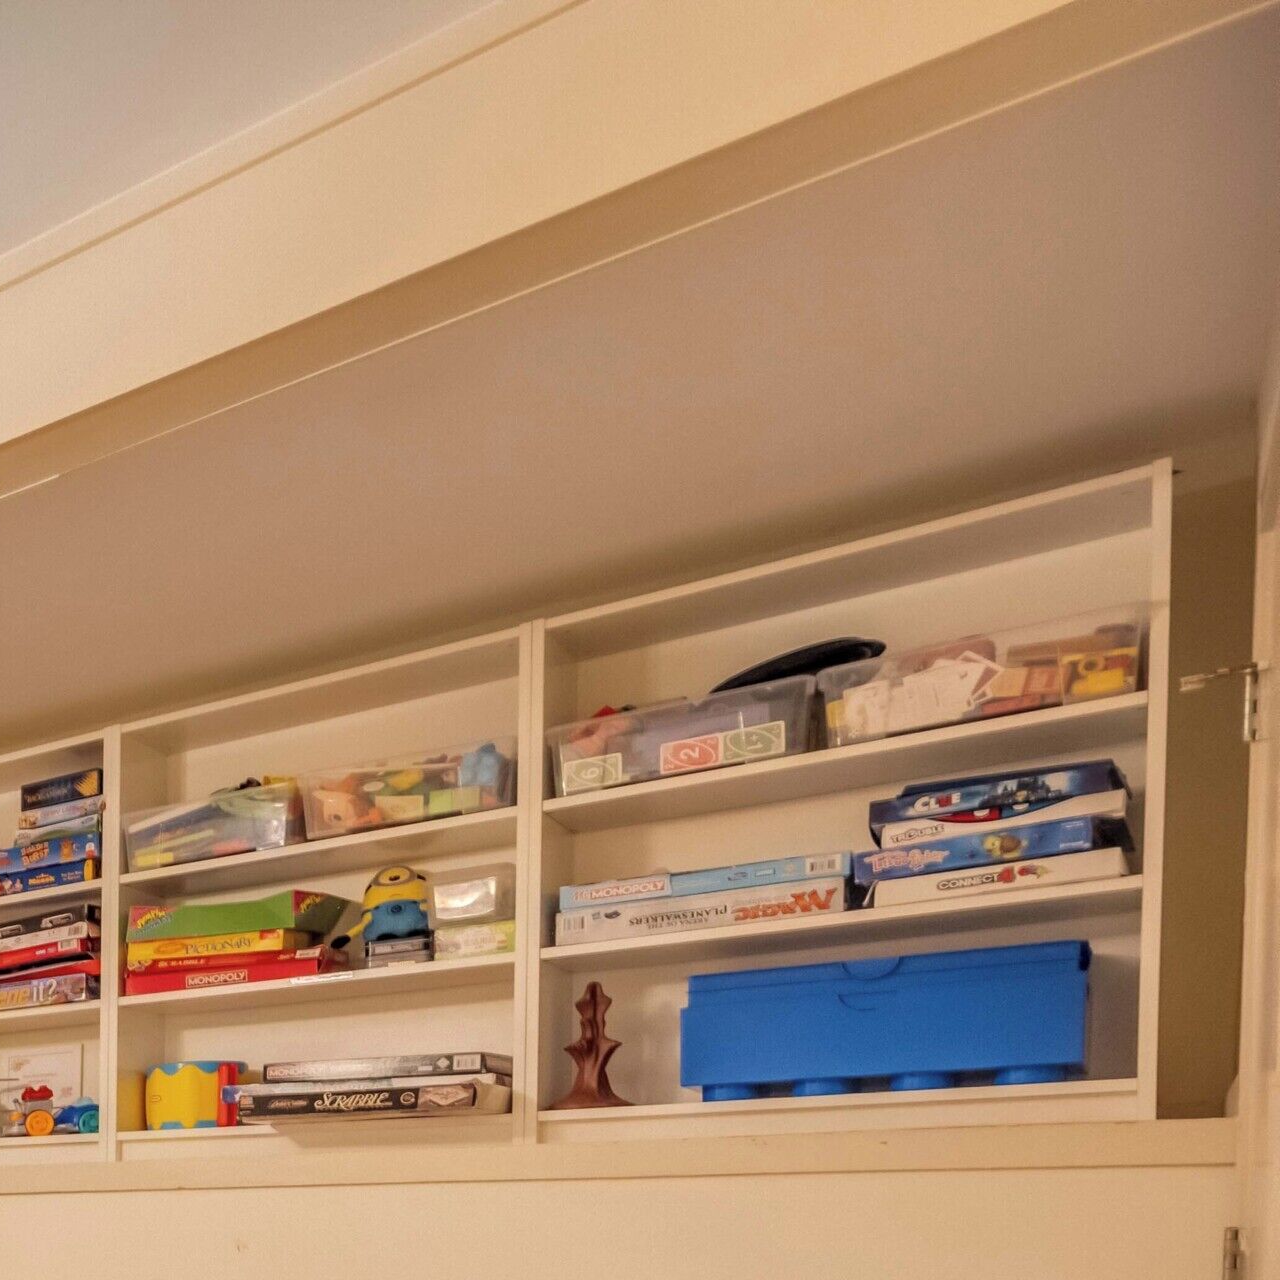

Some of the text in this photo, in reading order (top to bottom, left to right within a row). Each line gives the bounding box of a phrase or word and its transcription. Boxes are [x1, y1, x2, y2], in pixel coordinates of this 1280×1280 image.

[680, 747, 699, 759] 2
[914, 793, 961, 812] CLUE
[891, 824, 944, 843] TROUBLE
[937, 866, 1015, 890] CONNECT 4
[591, 880, 665, 899] MONOPOLY
[731, 888, 837, 920] MAGIC
[629, 905, 728, 926] PLANESWALKERS
[188, 971, 246, 986] MONOPOLY
[314, 1091, 393, 1111] SCRABBLE
